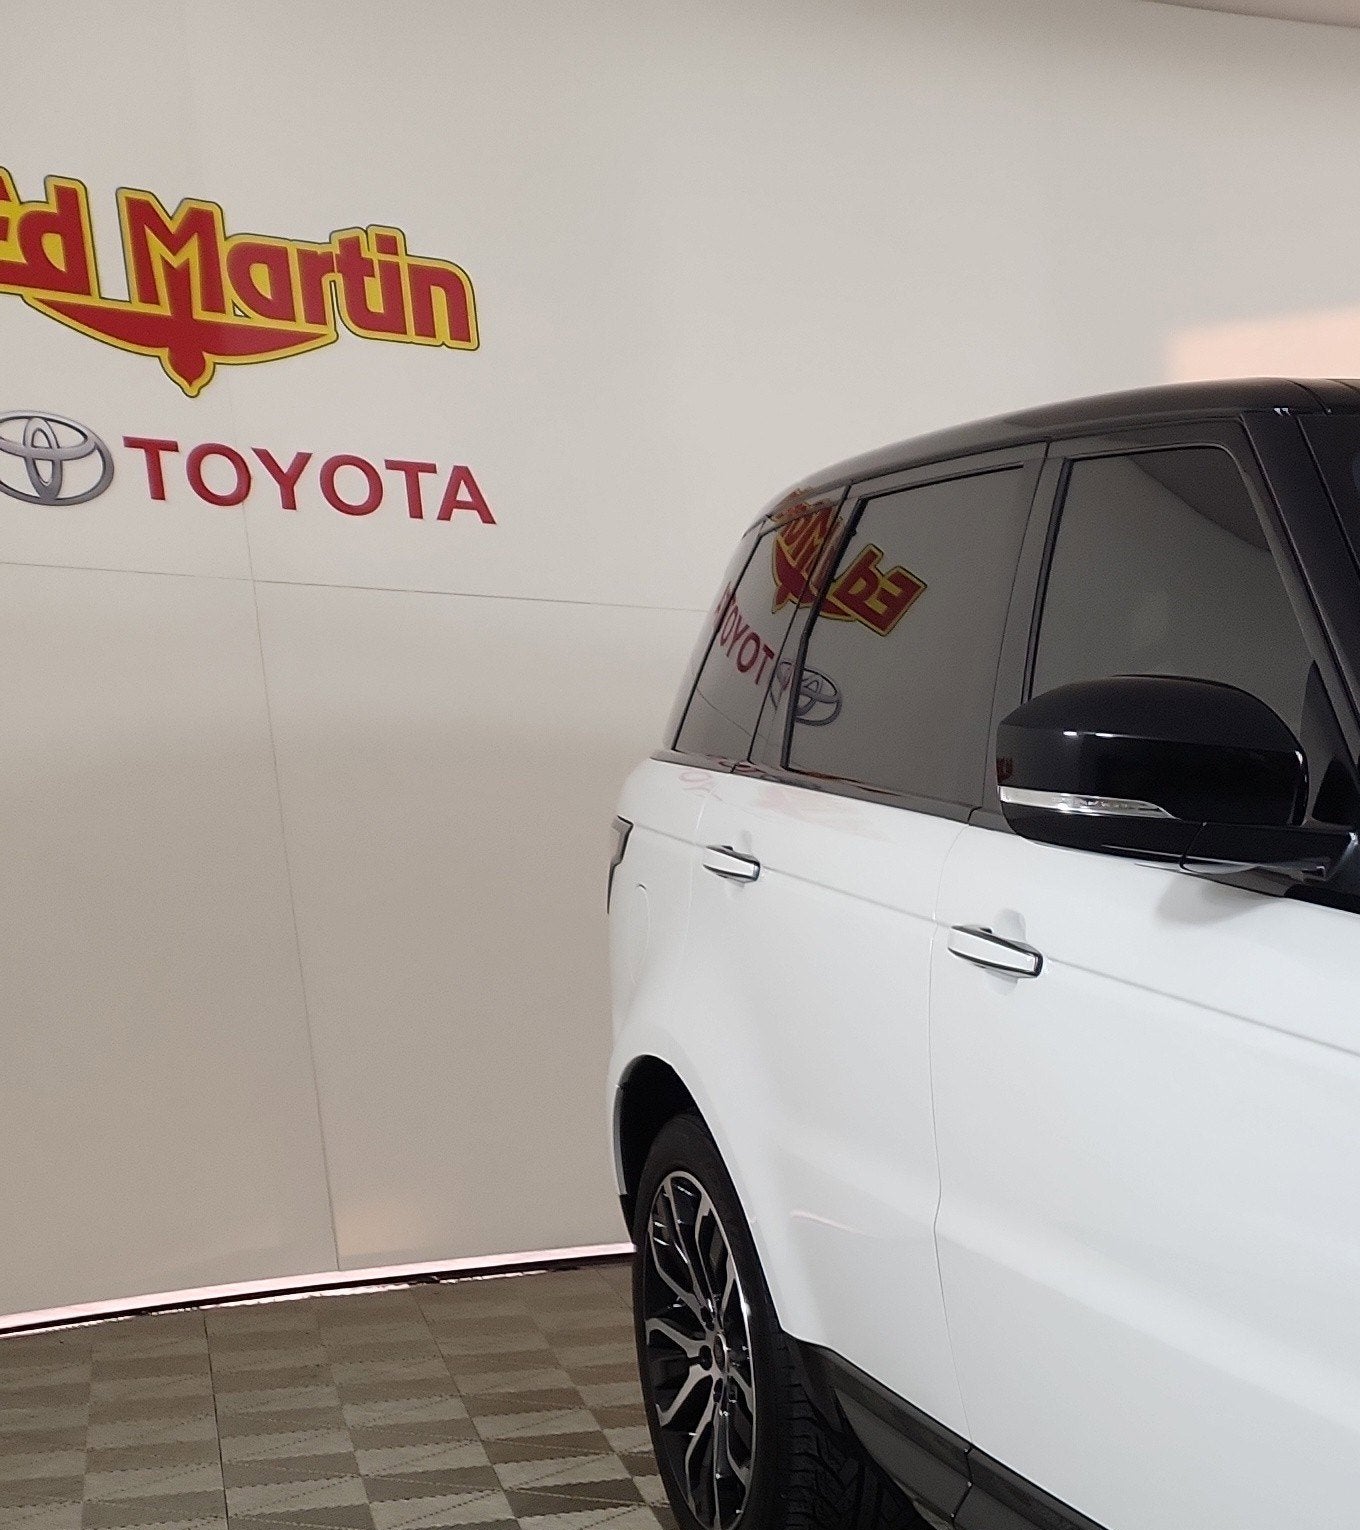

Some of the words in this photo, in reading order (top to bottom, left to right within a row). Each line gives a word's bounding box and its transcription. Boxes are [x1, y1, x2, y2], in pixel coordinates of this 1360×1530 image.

[0, 172, 92, 297] d
[124, 194, 472, 346] Martin
[123, 436, 497, 526] TOYOTA
